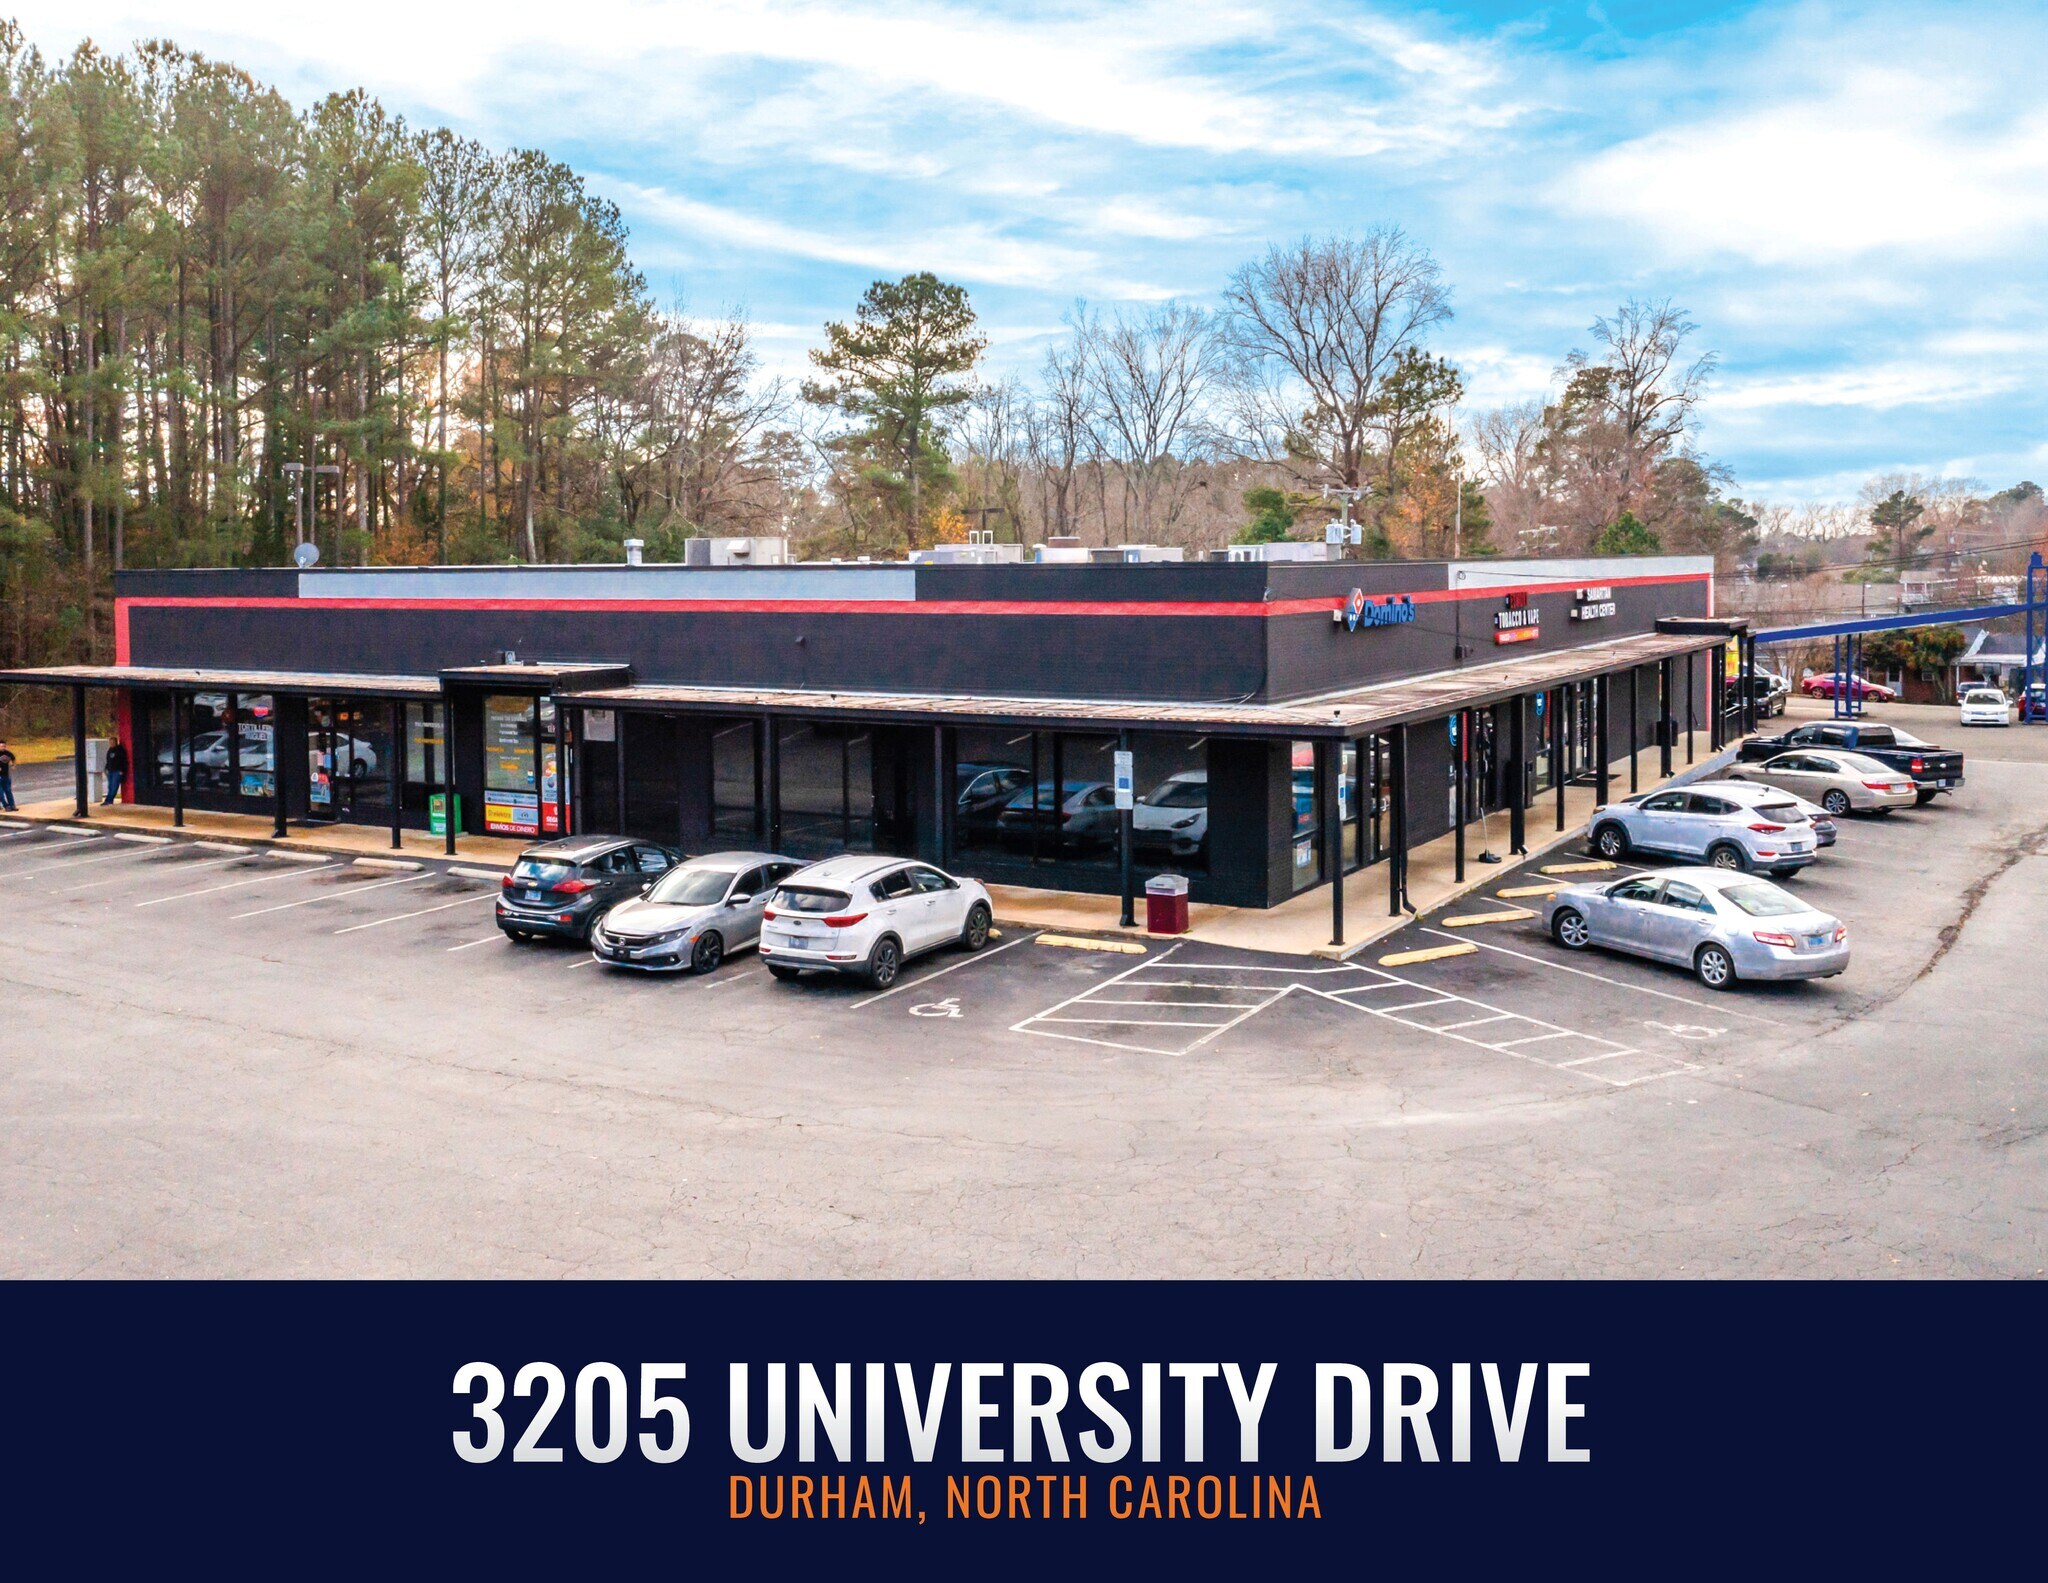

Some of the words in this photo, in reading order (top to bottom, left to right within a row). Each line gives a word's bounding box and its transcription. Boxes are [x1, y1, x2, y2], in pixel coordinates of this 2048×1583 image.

[1364, 594, 1416, 628] Domino's
[1498, 611, 1522, 629] TOBACCO
[1523, 610, 1527, 625] &
[1527, 608, 1540, 625] VAPE
[1581, 604, 1599, 620] HEALTH
[1599, 602, 1616, 617] CENTER
[516, 825, 536, 833] DINERO
